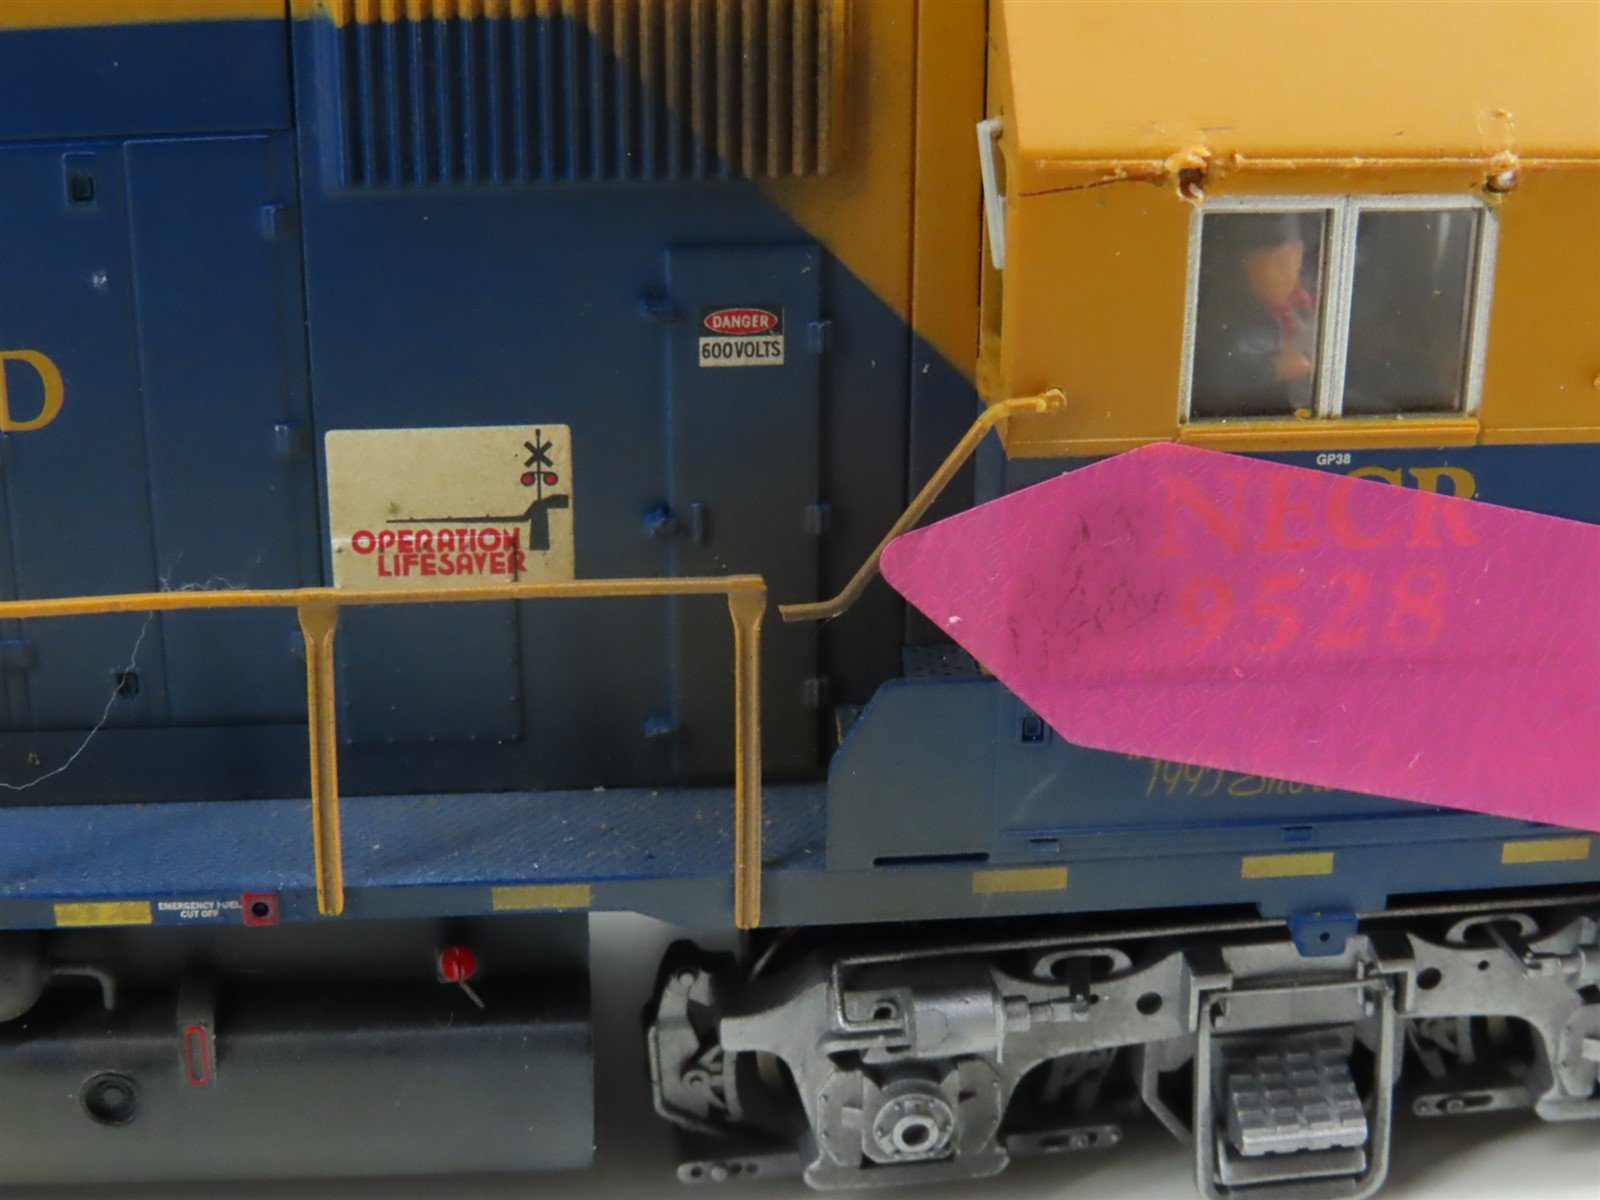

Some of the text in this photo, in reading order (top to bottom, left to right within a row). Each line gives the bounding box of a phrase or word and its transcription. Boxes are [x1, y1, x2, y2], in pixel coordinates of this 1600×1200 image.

[712, 315, 769, 328] DANGER
[0, 349, 64, 432] D
[1316, 453, 1351, 465] GP38
[1153, 466, 1481, 556] NECR
[352, 528, 520, 554] OPERATION
[377, 552, 527, 577] LIFESAVER
[1177, 567, 1448, 656] 9528
[158, 901, 215, 910] EMERGENCY
[180, 909, 219, 918] CUT OFF
